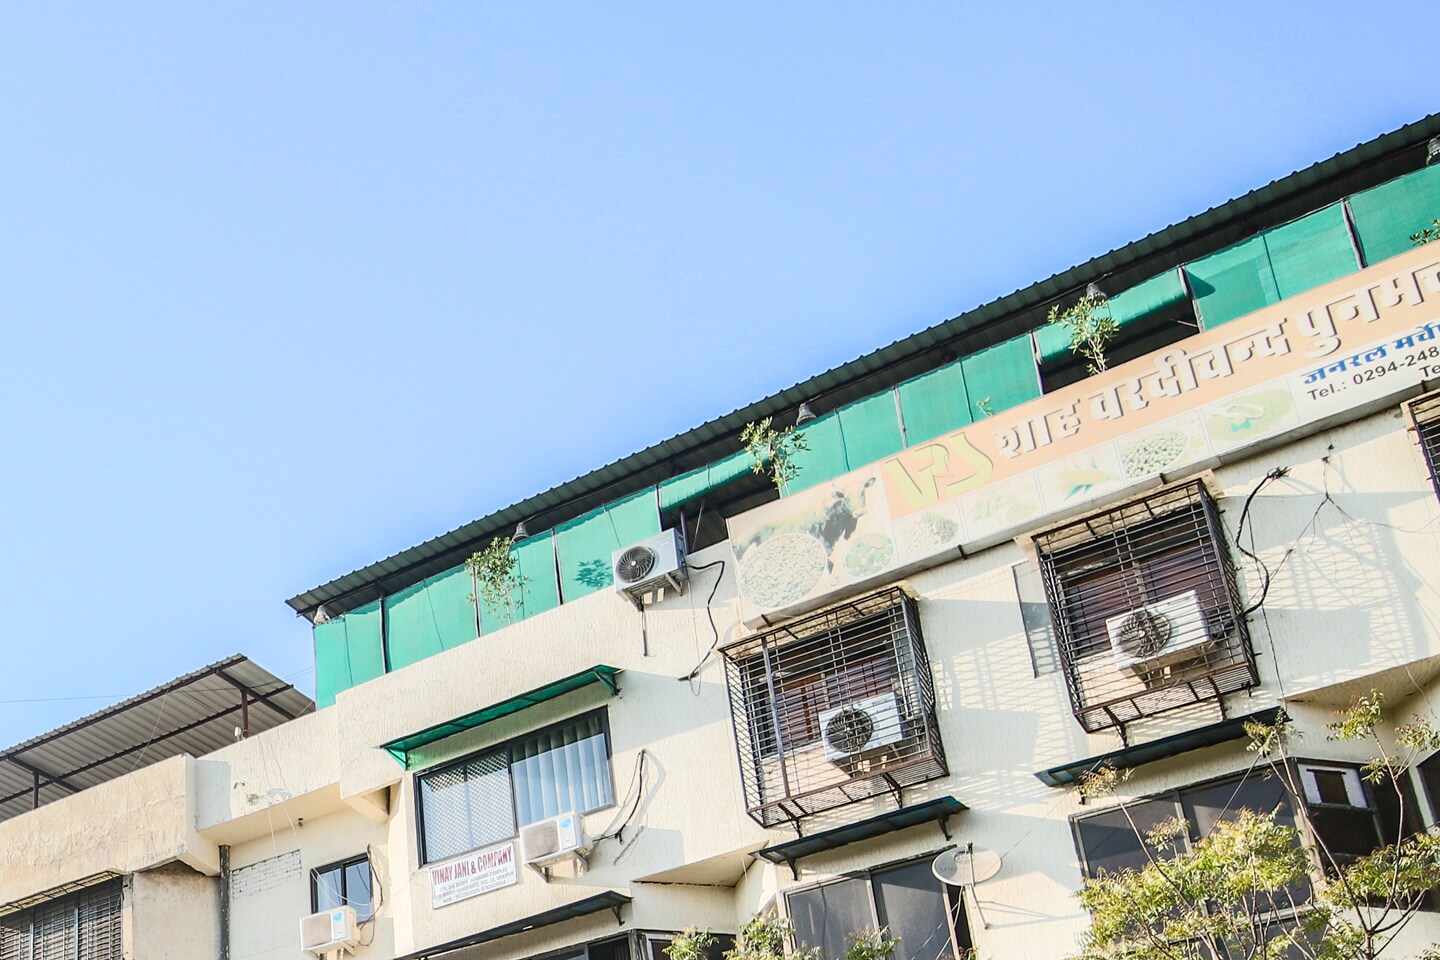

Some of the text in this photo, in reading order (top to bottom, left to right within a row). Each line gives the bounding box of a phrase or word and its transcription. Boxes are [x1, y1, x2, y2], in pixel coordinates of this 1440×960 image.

[1300, 321, 1440, 385] जनरल मर्चे
[1307, 345, 1440, 401] Tel.: 0294-248
[993, 399, 1081, 458] शाह
[432, 846, 512, 885] VINAY JANI & COMPANY
